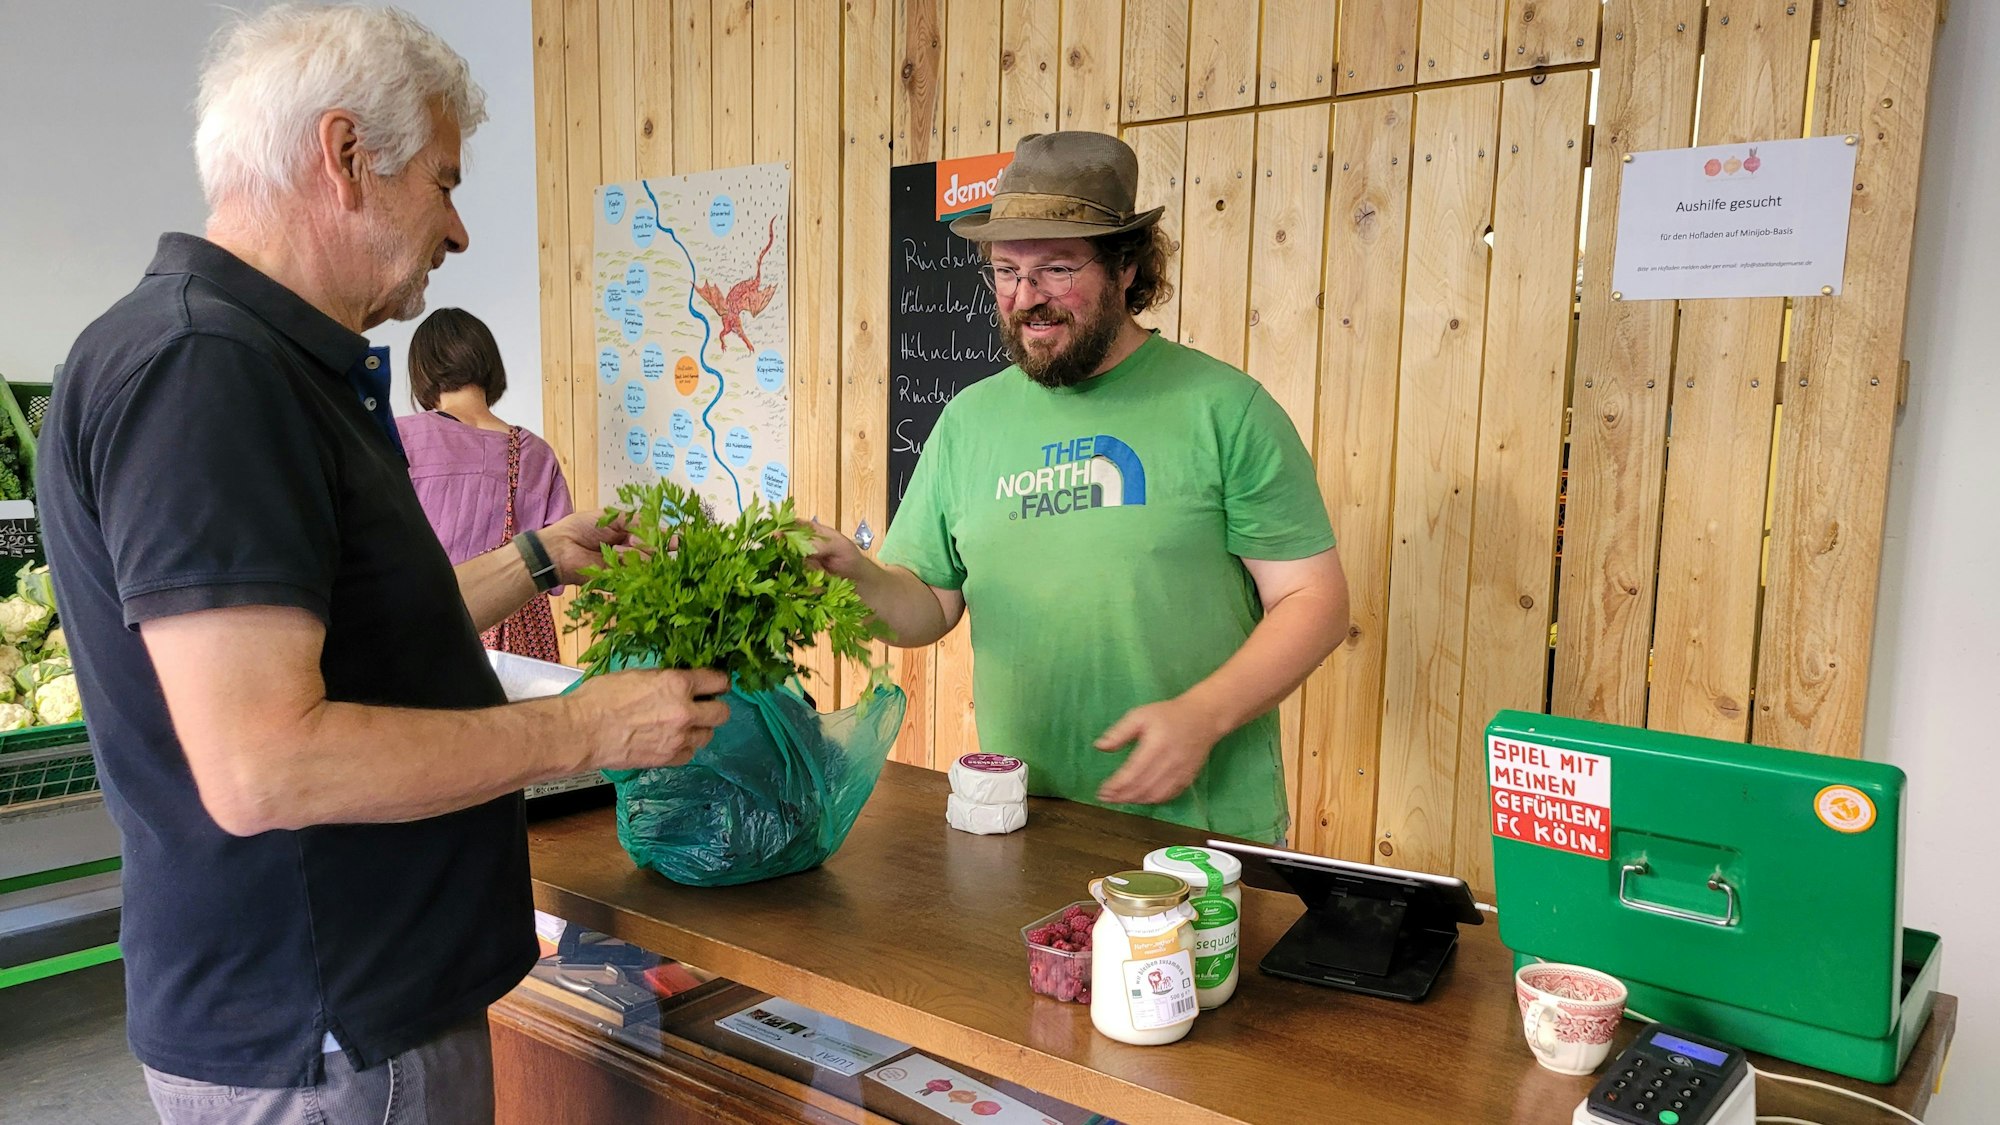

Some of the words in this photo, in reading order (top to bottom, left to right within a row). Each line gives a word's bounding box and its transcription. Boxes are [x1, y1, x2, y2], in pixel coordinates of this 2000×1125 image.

[1675, 198, 1726, 213] Aushilfe
[1729, 195, 1782, 212] gesucht
[1660, 233, 1671, 241] für
[1672, 232, 1687, 241] den
[1689, 231, 1724, 240] Hofladen
[1725, 229, 1739, 238] auf
[1740, 227, 1793, 238] Minijob-Basis
[1041, 437, 1094, 467] THE
[995, 460, 1091, 500] NORTH
[1021, 485, 1089, 519] FACE
[1494, 740, 1550, 768] SPIEL
[1560, 753, 1599, 776] MIT
[1495, 765, 1575, 796] MEINEN
[1494, 790, 1607, 833] GEFÜHLEN,
[1496, 812, 1520, 837] FC
[1533, 820, 1604, 854] KÖLN.
[1196, 928, 1238, 951] sequark
[1138, 960, 1158, 976] bleiben
[1159, 959, 1185, 976] zusammen
